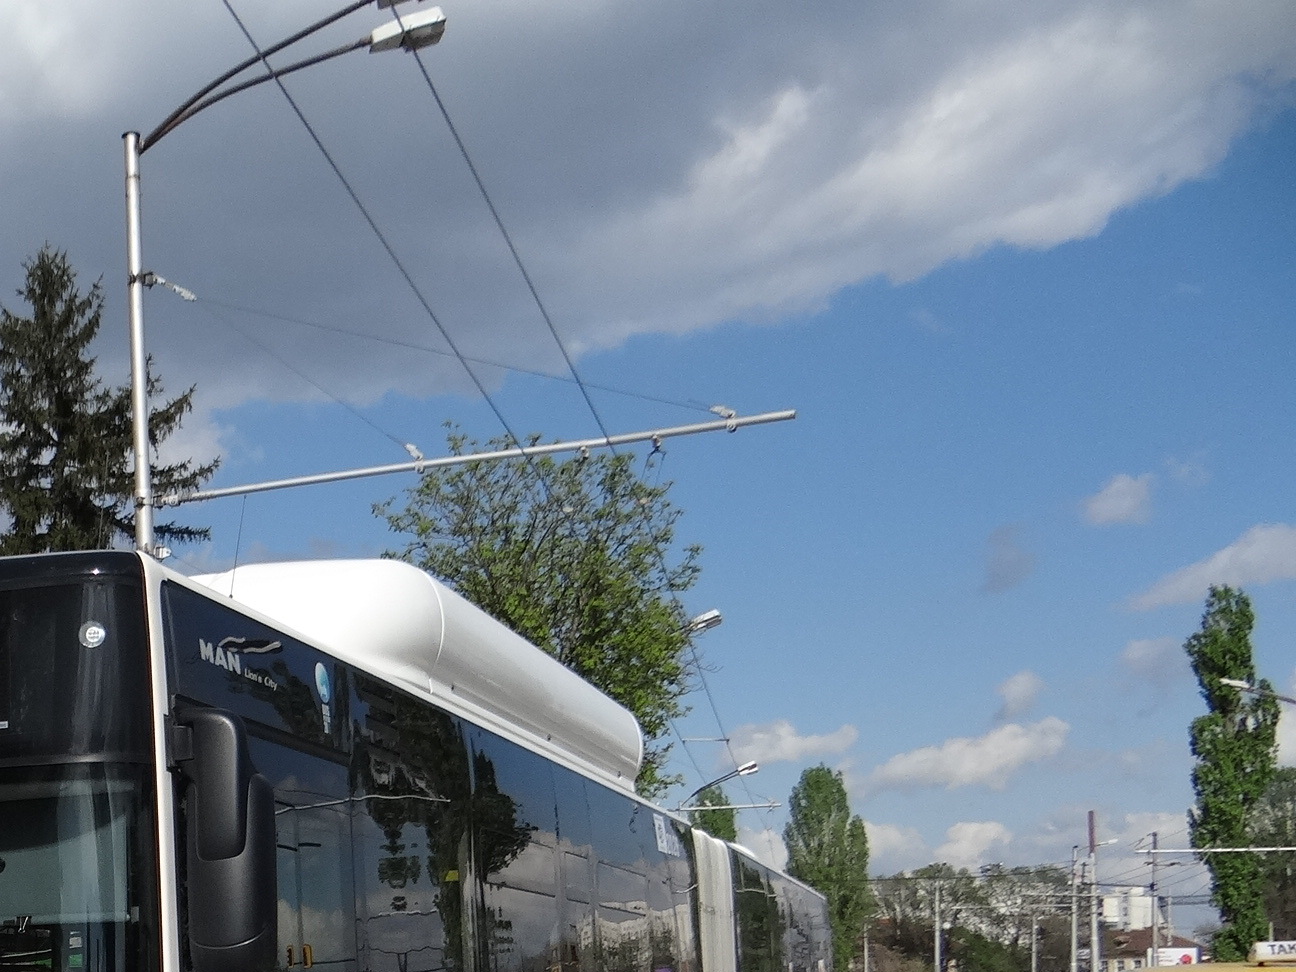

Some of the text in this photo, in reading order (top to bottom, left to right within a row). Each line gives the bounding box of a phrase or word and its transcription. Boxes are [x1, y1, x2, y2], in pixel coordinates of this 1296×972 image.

[199, 638, 242, 675] MAN
[244, 667, 278, 691] Lion's City
